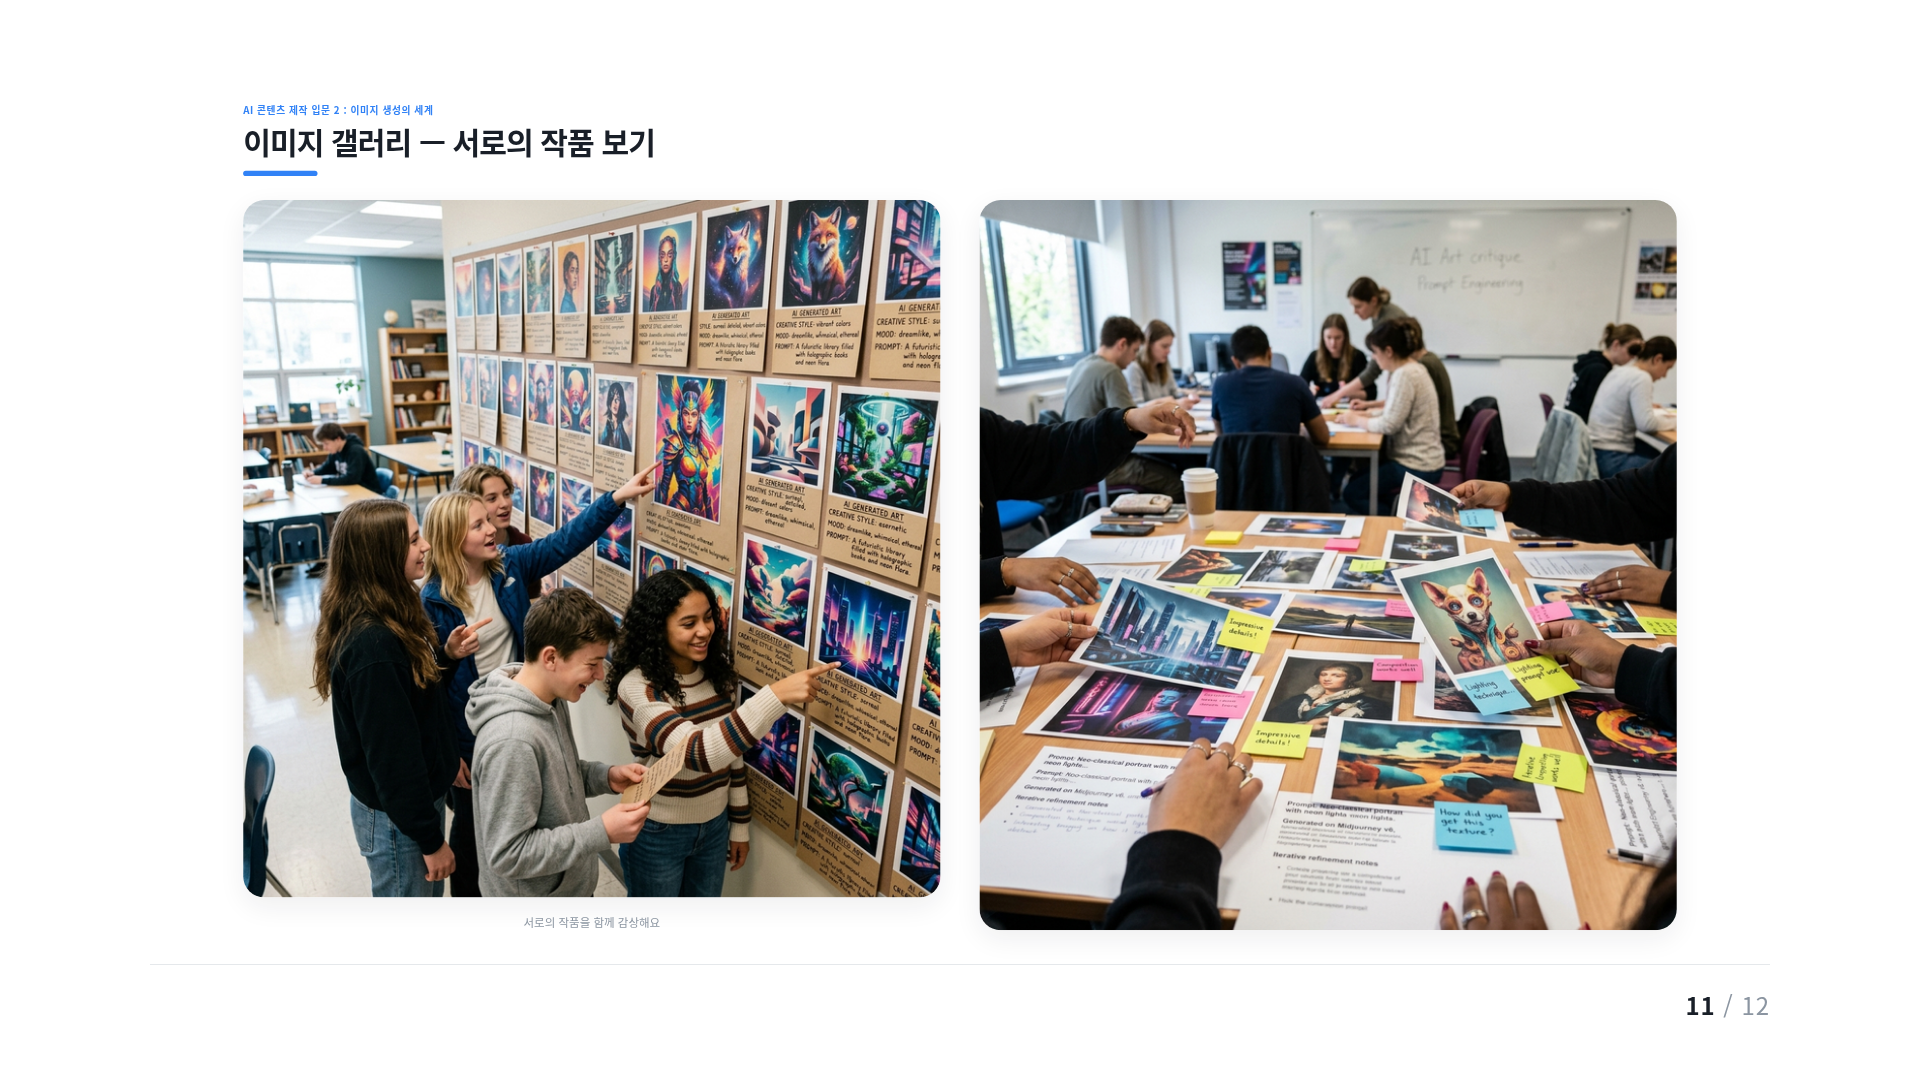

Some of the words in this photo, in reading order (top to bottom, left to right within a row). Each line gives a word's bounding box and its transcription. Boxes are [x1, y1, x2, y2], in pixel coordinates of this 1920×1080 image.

[1410, 247, 1432, 266] AI
[1440, 247, 1463, 265] Art
[1418, 275, 1455, 293] Prompt
[1461, 275, 1524, 296] Engineering
[899, 304, 906, 312] AI
[909, 303, 940, 311] GENERAT
[828, 508, 855, 520] CREATIVE
[852, 503, 888, 517] GENERATED
[890, 512, 904, 521] ART
[1513, 663, 1545, 674] Lighting
[1465, 681, 1498, 692] Lighting
[929, 719, 937, 728] AI
[1256, 730, 1301, 739] Impressive
[1077, 756, 1124, 766] Neo-classical
[1125, 762, 1152, 770] portrait
[1111, 776, 1136, 784] portrait
[1024, 784, 1061, 793] Generated
[1046, 797, 1086, 806] refinement
[1440, 808, 1460, 816] How
[1485, 813, 1502, 821] you
[1282, 818, 1324, 826] Generated
[1441, 818, 1458, 826] get
[1273, 852, 1306, 860] Iterative
[1308, 855, 1353, 864] refinement
[1355, 859, 1379, 867] notes
